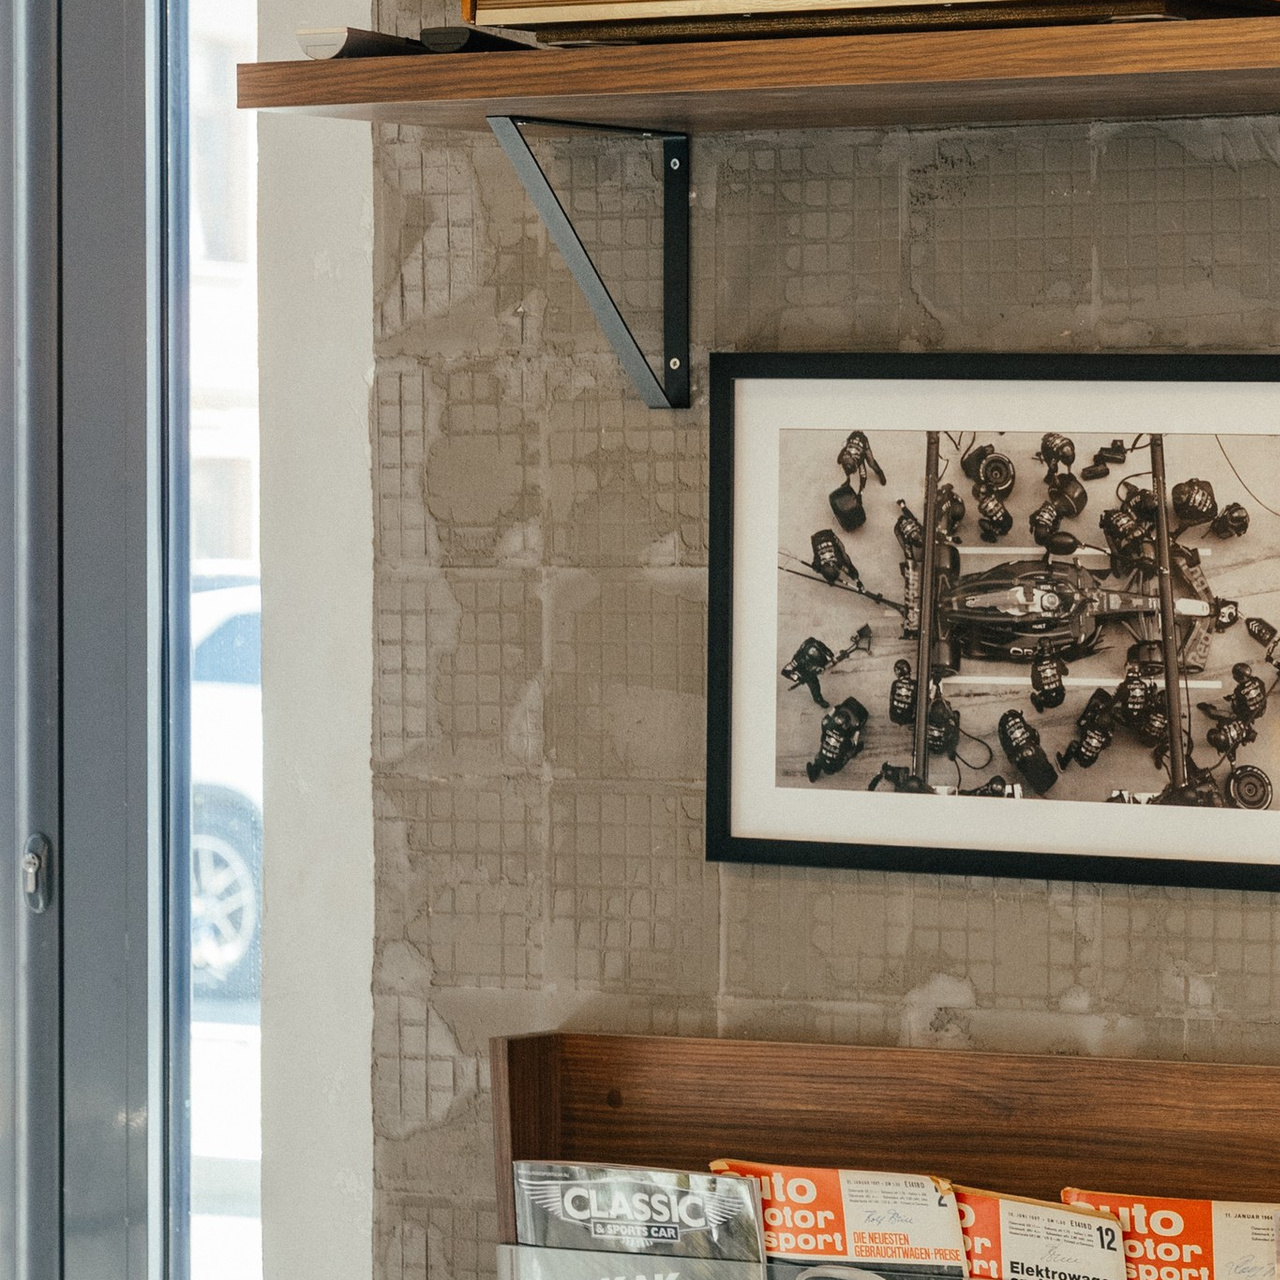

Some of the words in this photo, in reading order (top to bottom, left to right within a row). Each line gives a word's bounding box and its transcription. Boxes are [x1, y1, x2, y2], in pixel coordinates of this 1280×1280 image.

[563, 1186, 707, 1228] CLASSIC
[763, 1206, 835, 1229] otor
[595, 1223, 605, 1234] &
[606, 1224, 649, 1237] SPORTS
[650, 1226, 677, 1239] CAR
[764, 1230, 844, 1252] sport
[853, 1231, 868, 1244] DIE
[868, 1231, 910, 1246] NEUESTEN
[1096, 1225, 1117, 1252] 12
[1124, 1238, 1203, 1263] otor
